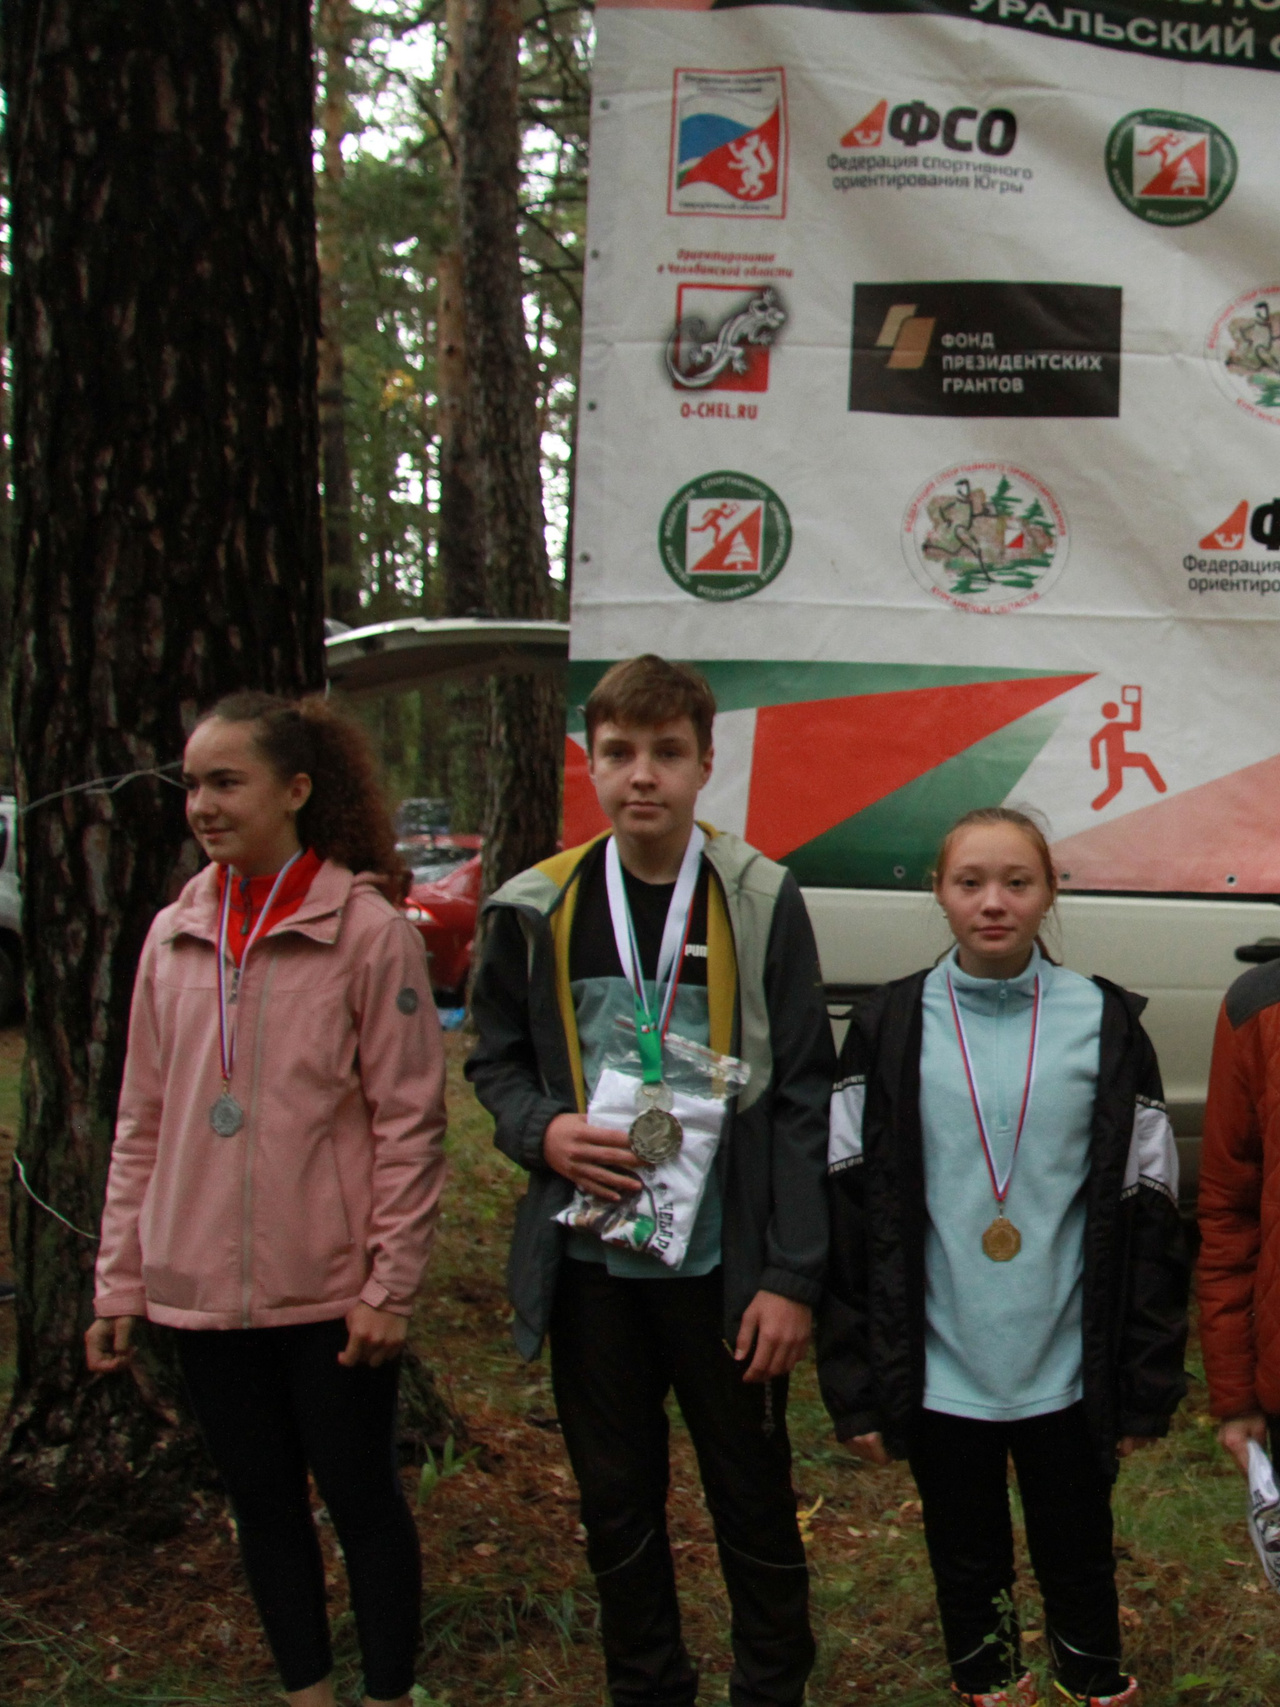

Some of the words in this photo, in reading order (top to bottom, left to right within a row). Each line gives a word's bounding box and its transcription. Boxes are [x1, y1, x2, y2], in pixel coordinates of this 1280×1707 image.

[888, 99, 1017, 157] ФСО
[827, 153, 919, 173] Федерация
[922, 156, 1034, 180] спортивного
[832, 172, 970, 193] ориентирования
[973, 174, 1024, 194] Югры
[941, 332, 996, 350] ФОНД
[942, 354, 1103, 373] ПРЕЗИДЕНТСКИХ
[943, 377, 1025, 394] ГРАНТОВ
[684, 944, 708, 958] PUM
